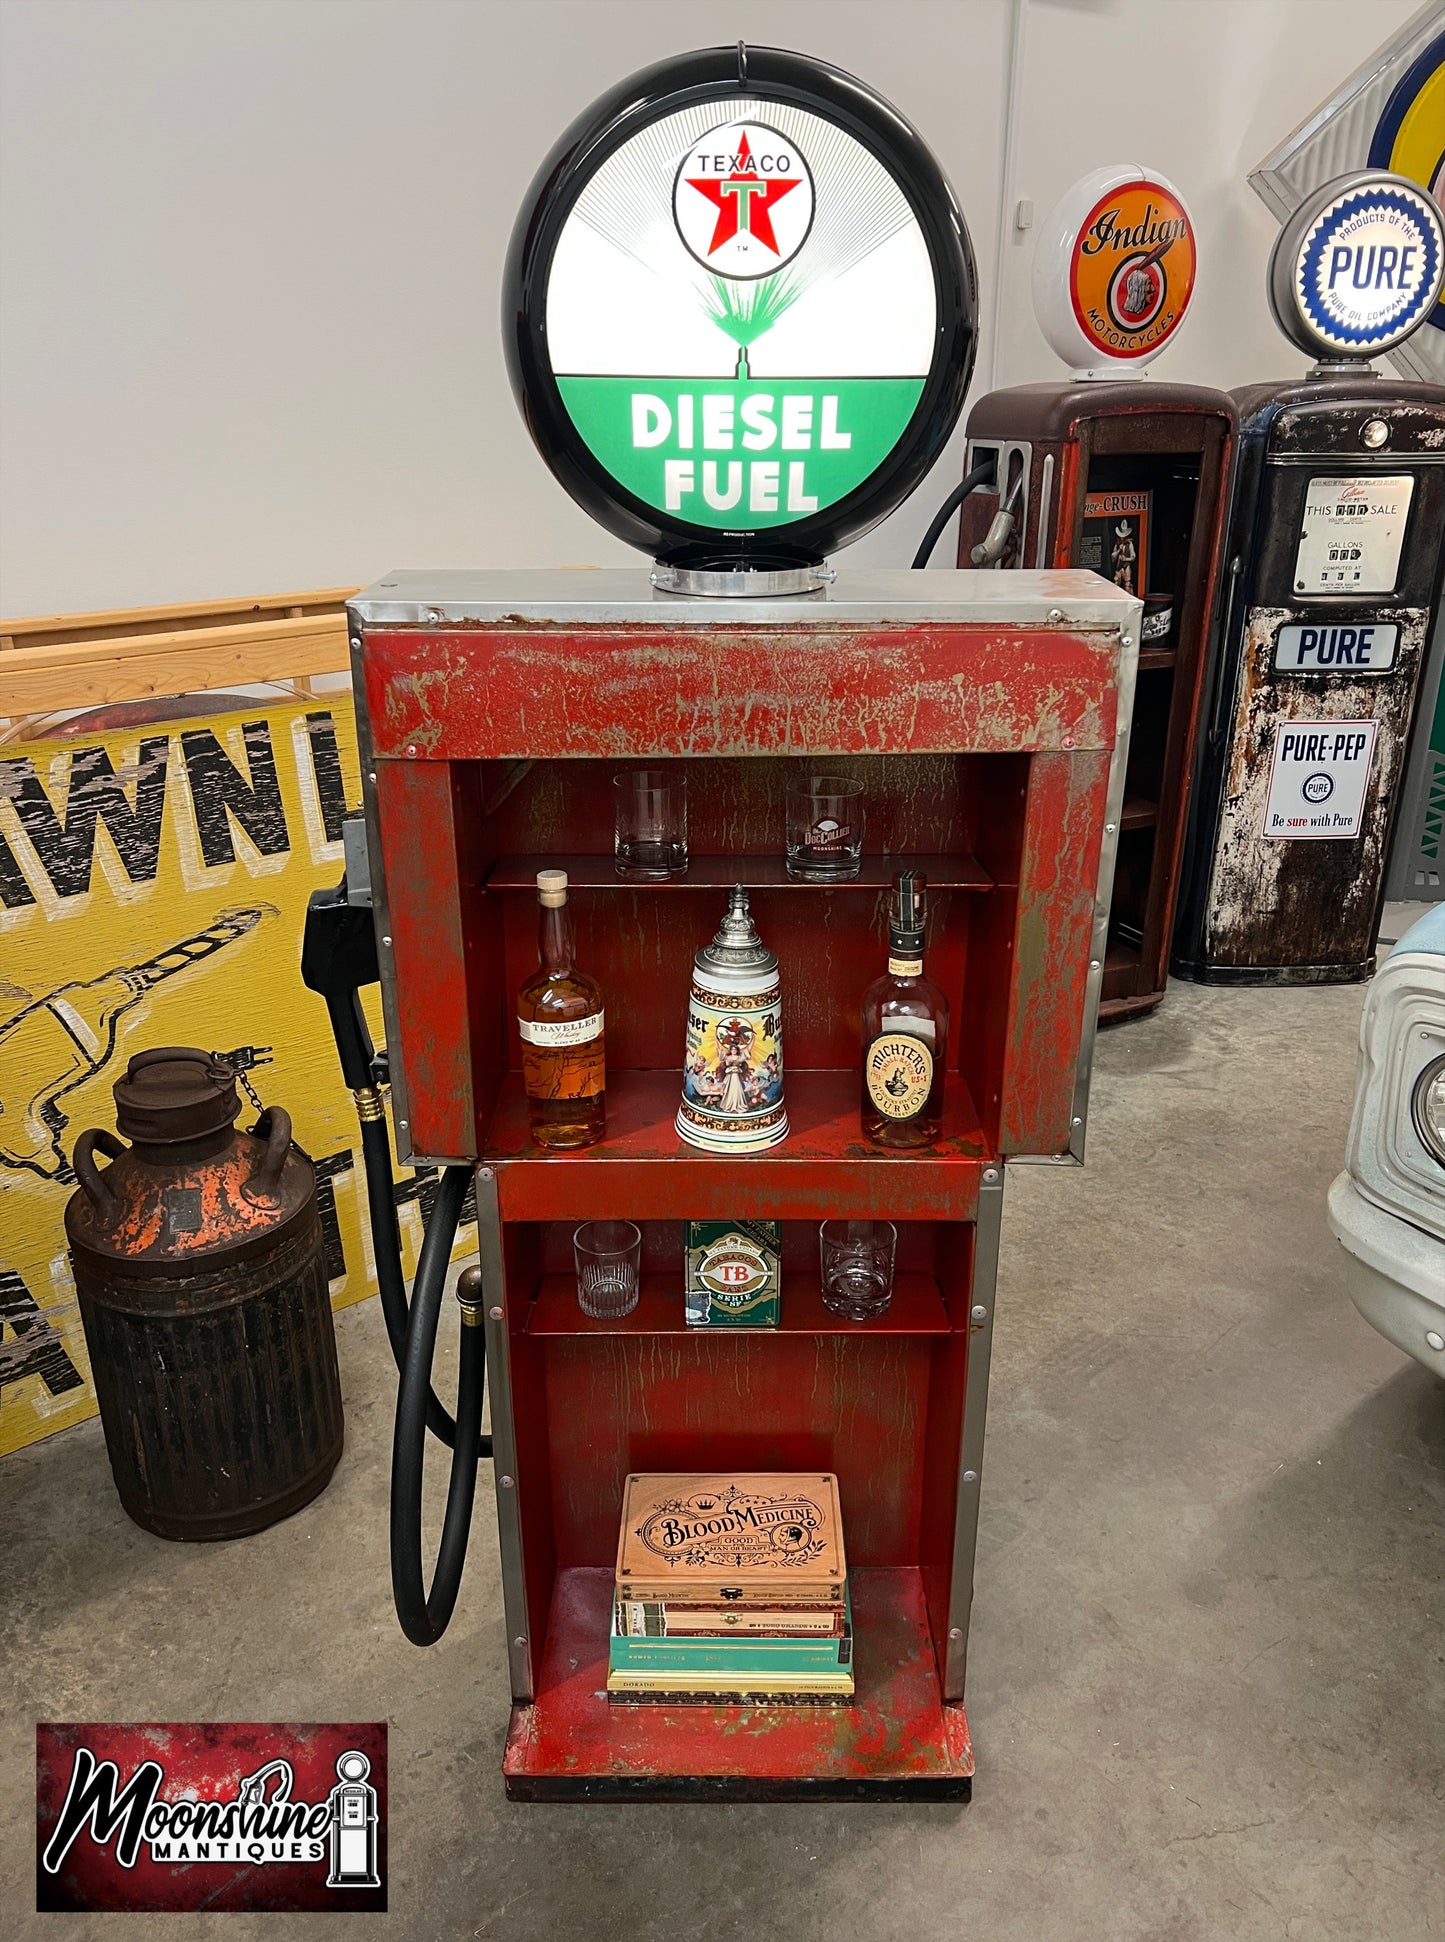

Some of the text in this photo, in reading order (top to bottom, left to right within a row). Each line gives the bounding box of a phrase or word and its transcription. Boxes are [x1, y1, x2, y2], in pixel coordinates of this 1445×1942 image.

[697, 154, 791, 173] TEXACO
[720, 181, 767, 231] T
[1082, 203, 1187, 255] Indian
[1339, 213, 1416, 241] PRODUCTS OF THE
[1328, 245, 1418, 290] PURE
[1328, 291, 1407, 321] PURE OIL COMPANY
[1087, 307, 1175, 350] MOTORCYCLES
[630, 393, 852, 451] DIESEL
[663, 459, 819, 513] FUEL
[1083, 494, 1148, 515] nge-CRUSH
[1306, 505, 1332, 516] THIS
[1370, 504, 1398, 515] SALE
[1327, 541, 1364, 549] GALLONS
[1297, 628, 1375, 665] PURE
[1281, 733, 1367, 762] PURE-PEP
[1307, 783, 1329, 793] PURE
[1272, 812, 1353, 827] Be sure with Pure
[532, 1016, 597, 1033] TRAVELLER
[872, 1043, 927, 1075] MICHTER'S
[881, 1056, 915, 1076] SMALL BATCH
[709, 1253, 758, 1267] TABACOS
[719, 1265, 750, 1282] TB
[717, 1293, 752, 1302] SERIE
[661, 1505, 817, 1548] BLOOD MEDICINE
